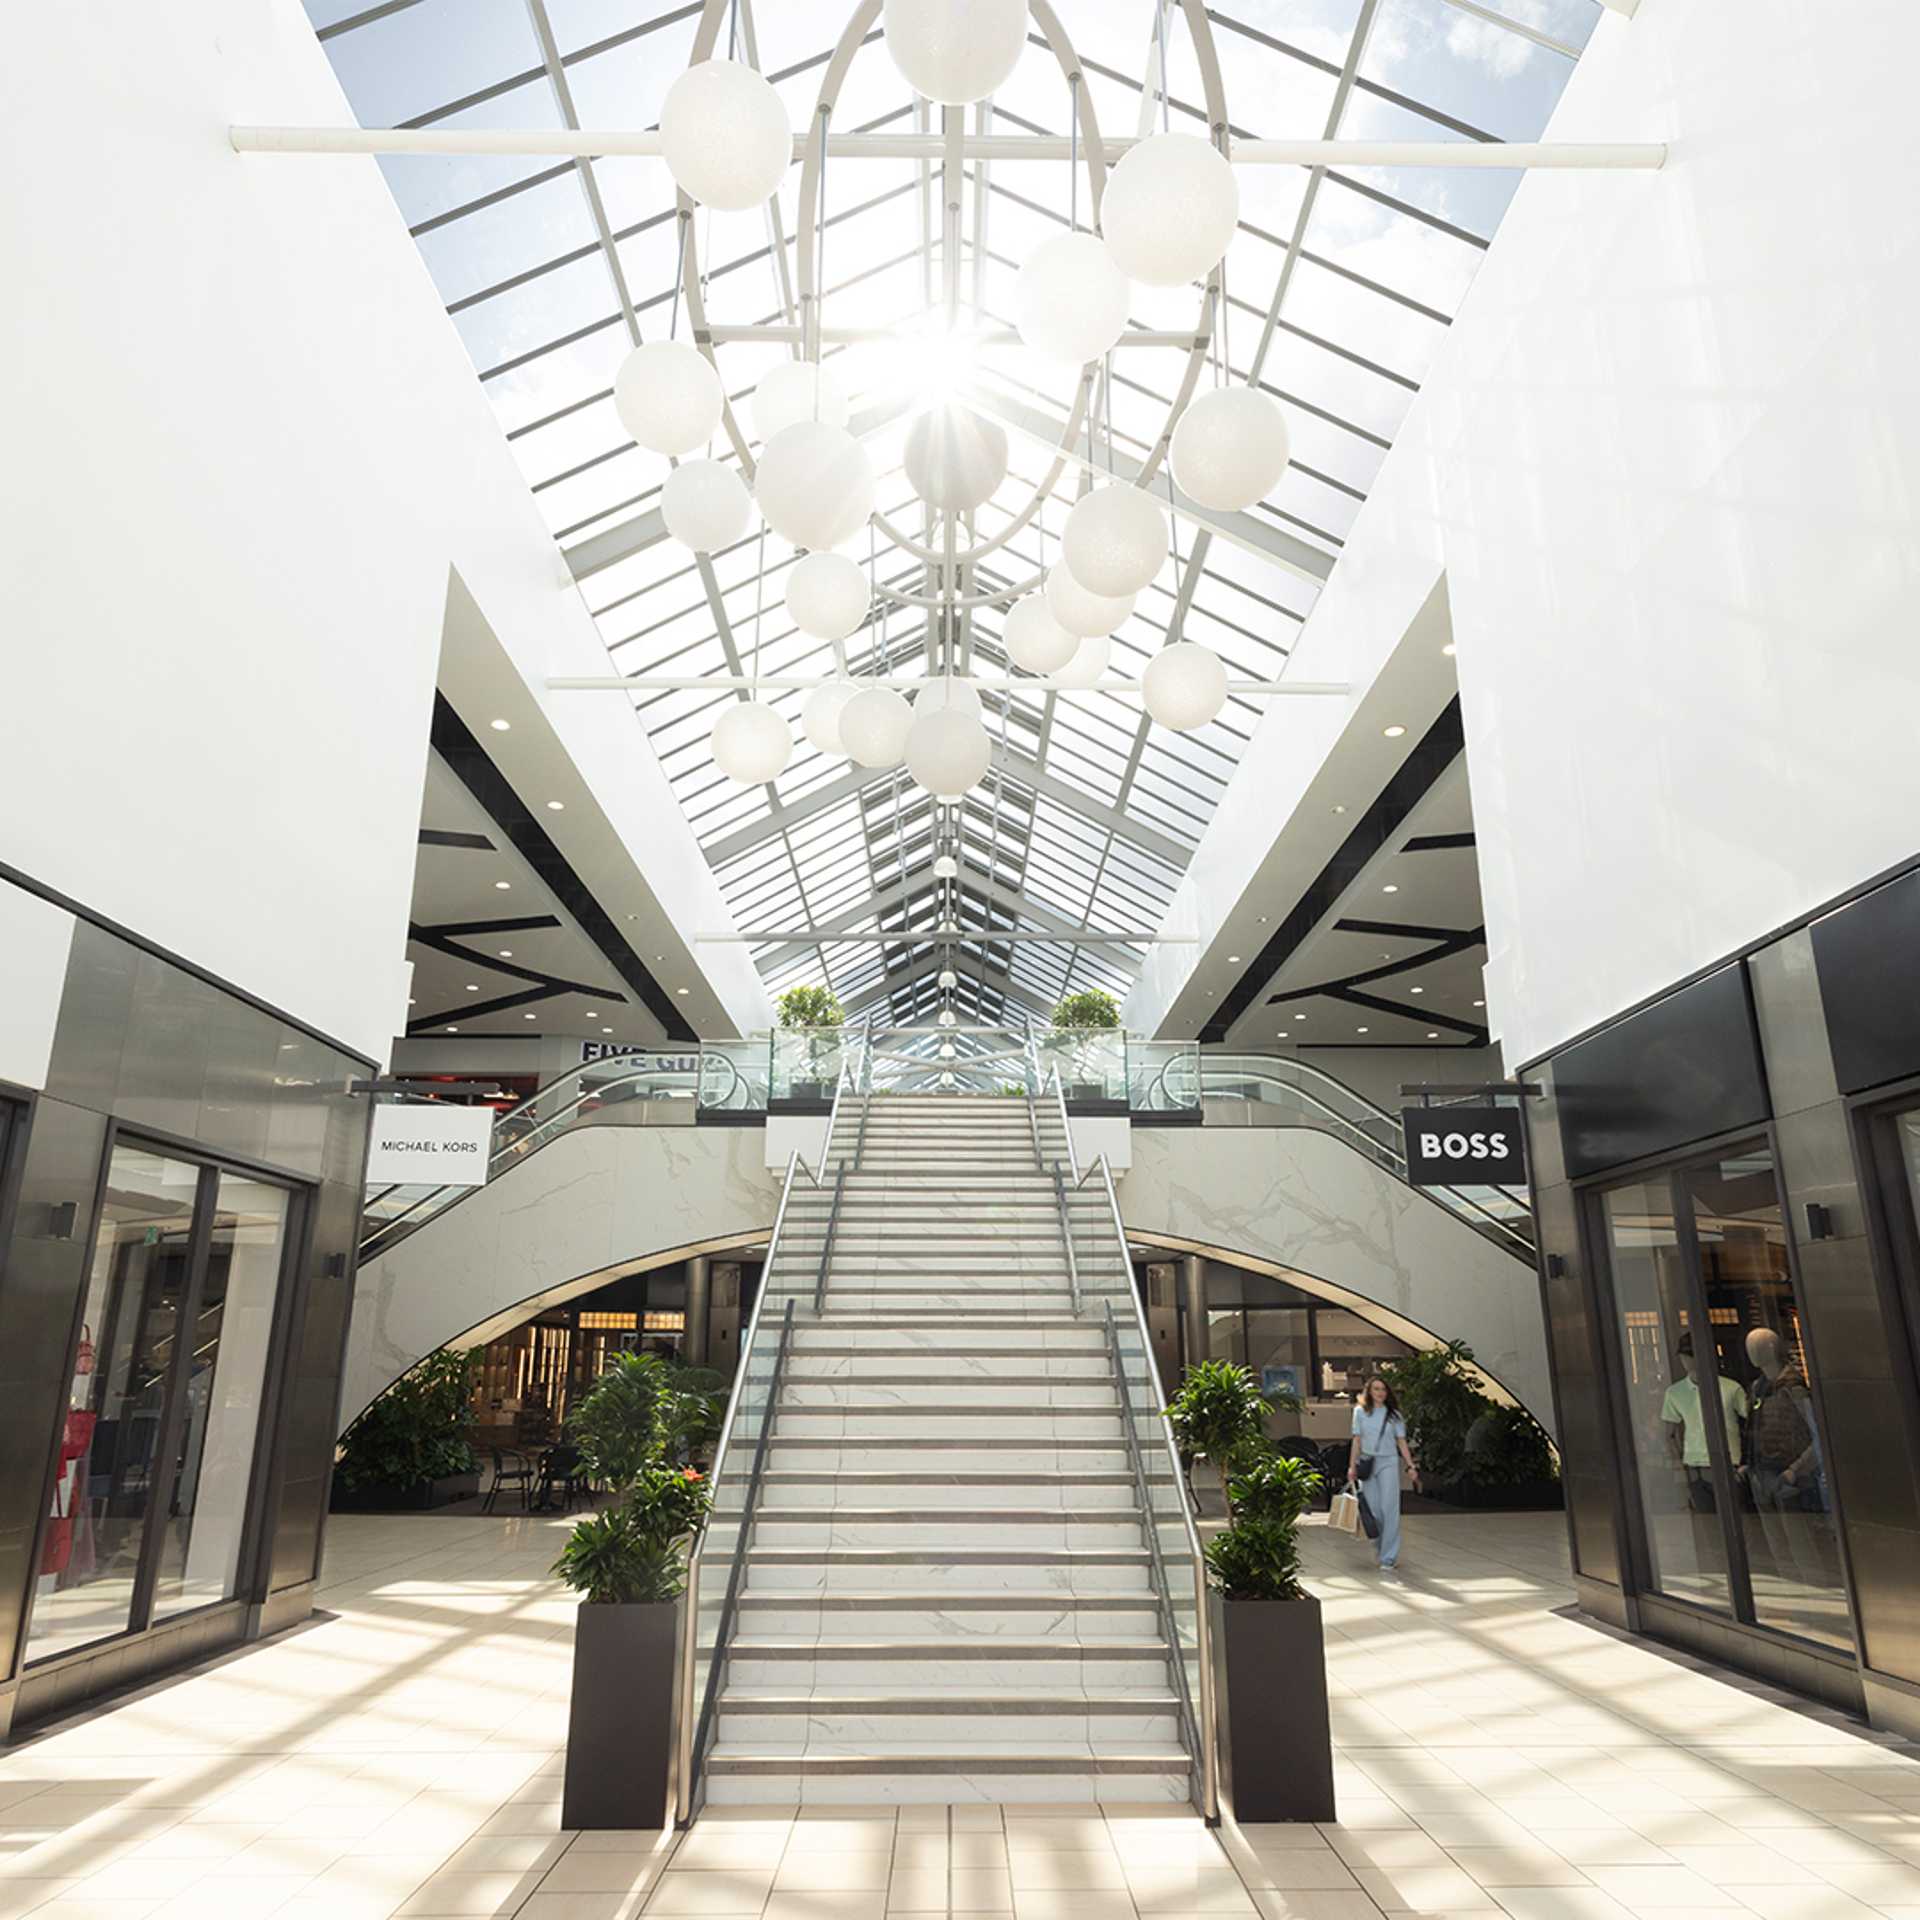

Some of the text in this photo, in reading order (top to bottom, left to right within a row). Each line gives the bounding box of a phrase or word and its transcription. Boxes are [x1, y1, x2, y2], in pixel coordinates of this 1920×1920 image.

[583, 1041, 647, 1067] FIVE
[381, 1141, 478, 1153] MICHAEL KORS
[1420, 1133, 1509, 1159] BOSS
